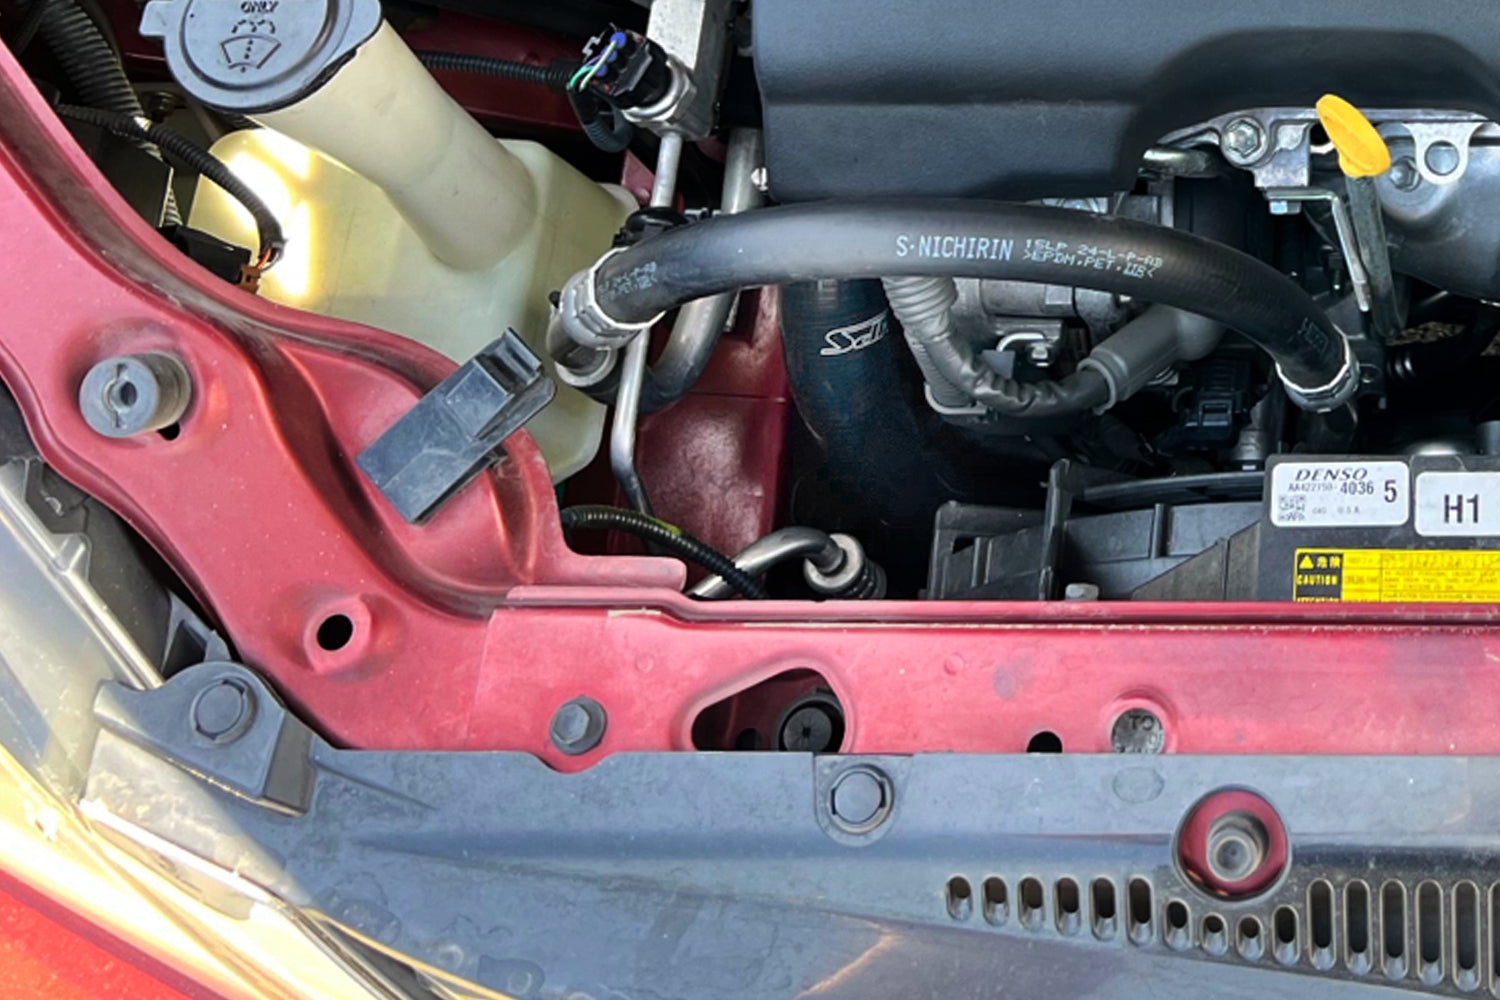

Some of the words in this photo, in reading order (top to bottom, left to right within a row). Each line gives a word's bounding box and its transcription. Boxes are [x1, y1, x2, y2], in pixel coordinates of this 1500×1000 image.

[240, 1, 279, 13] ONLY
[1294, 467, 1369, 481] DENSO
[1340, 480, 1375, 495] 4036
[1384, 479, 1398, 503] 5
[1443, 494, 1480, 523] H1
[1296, 574, 1338, 586] CAUTION
